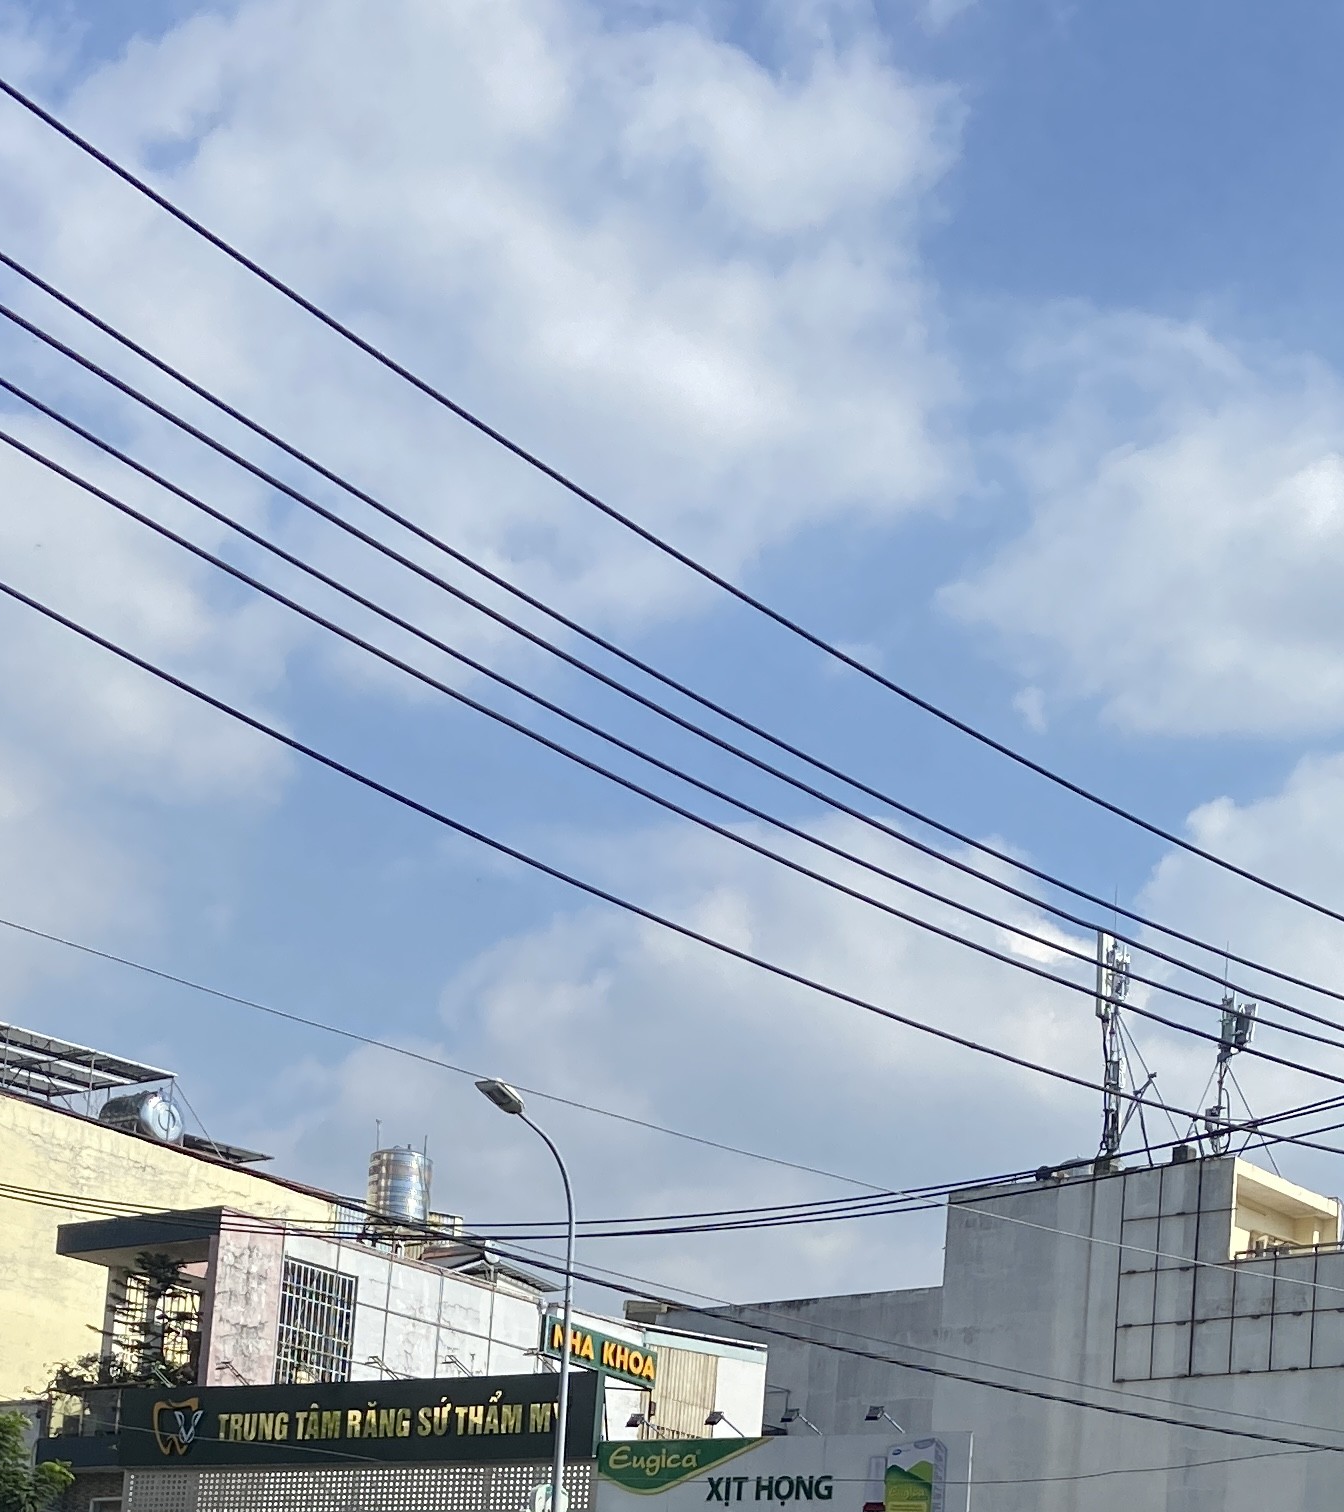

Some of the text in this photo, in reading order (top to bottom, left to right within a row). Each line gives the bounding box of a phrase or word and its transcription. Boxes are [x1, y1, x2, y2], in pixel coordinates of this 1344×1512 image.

[553, 1324, 655, 1380] NHA KHOA
[218, 1412, 288, 1442] TRUNG
[296, 1403, 341, 1440] TÂM
[346, 1401, 411, 1439] RĂNG
[417, 1397, 453, 1437] SỨ
[456, 1390, 522, 1436] THẨM
[706, 1475, 833, 1506] XỊT HỌNG
